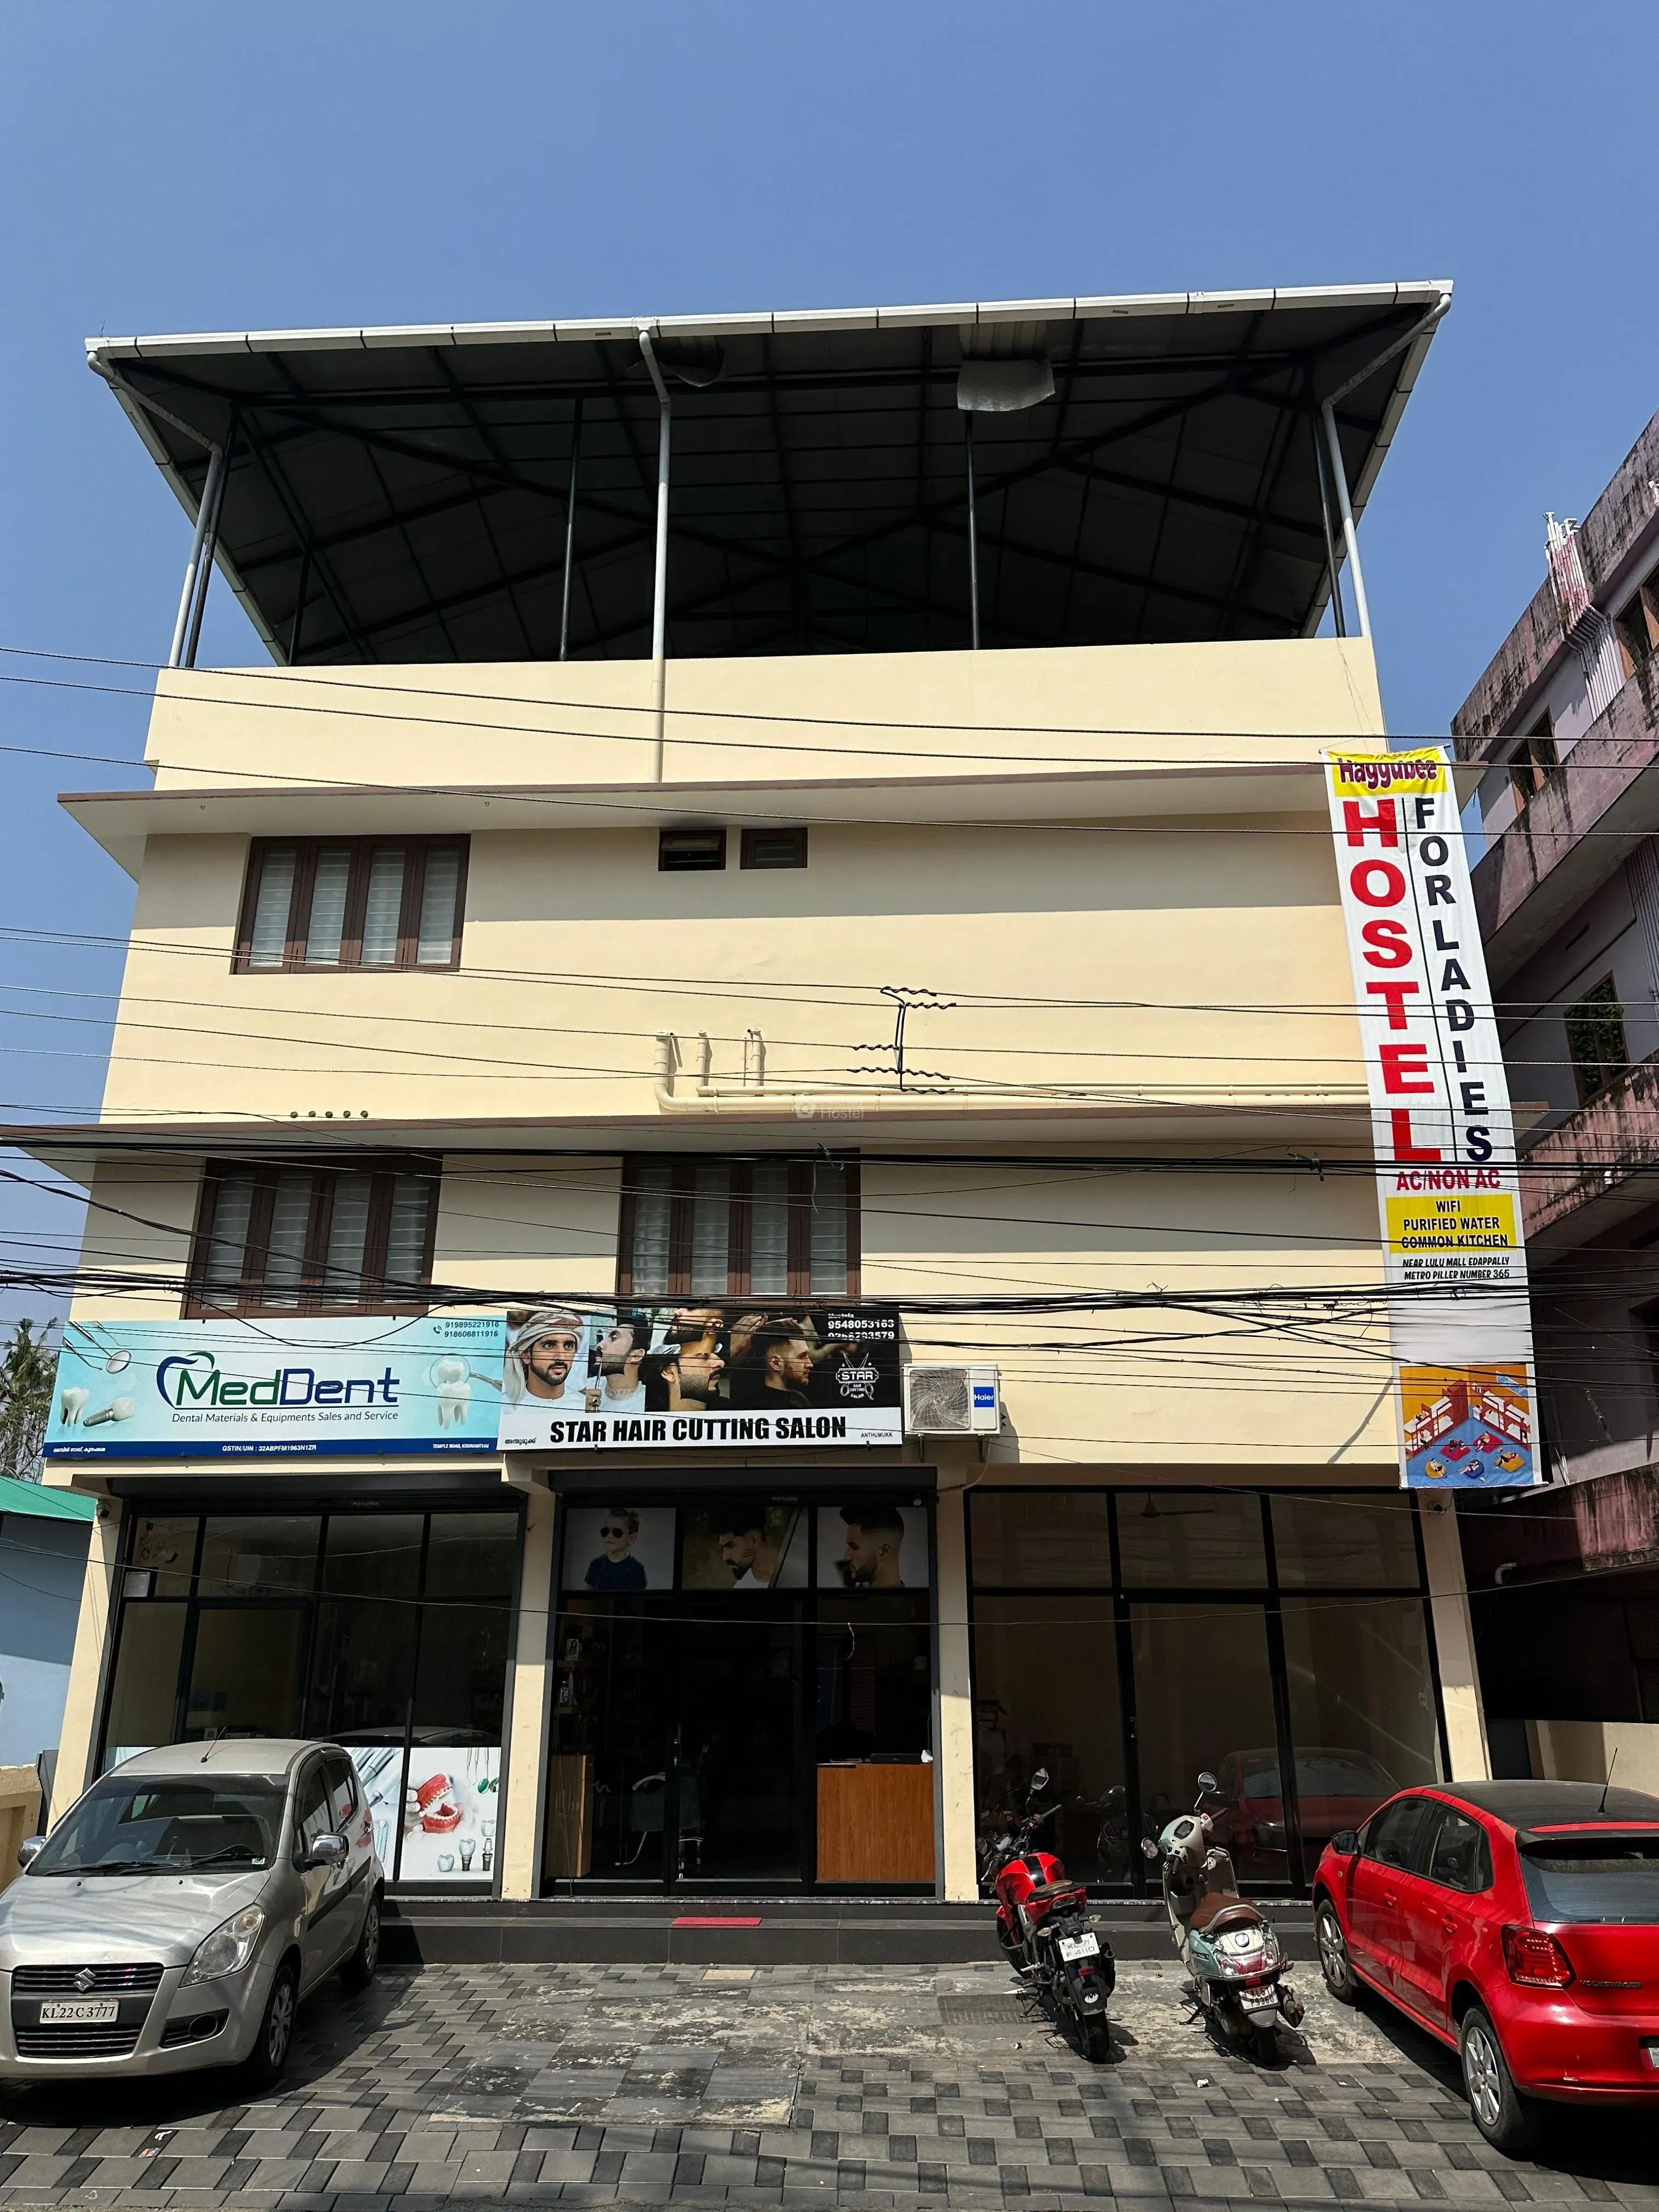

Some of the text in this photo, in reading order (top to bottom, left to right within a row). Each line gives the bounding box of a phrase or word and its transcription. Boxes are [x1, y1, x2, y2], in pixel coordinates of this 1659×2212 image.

[1342, 798, 1442, 1161] HOSTEL
[1415, 797, 1493, 1162] FOR LADIES
[1396, 1169, 1500, 1190] AC/NON AC
[1436, 1200, 1461, 1212] WIFI
[1403, 1217, 1500, 1231] PURIFIED WATER
[1401, 1234, 1508, 1249] COMMON KITCHEN
[1402, 1256, 1510, 1267] NEAR LULU MALL EDAPPALLY
[1404, 1268, 1510, 1280] METRO PILLER NUMBER 365
[841, 1371, 873, 1380] STAR
[176, 1367, 400, 1406] MedDent
[172, 1410, 399, 1424] Dental Materials & Equipments Sales and Service
[550, 1417, 847, 1443] STAR HAIR CUTTING SALON
